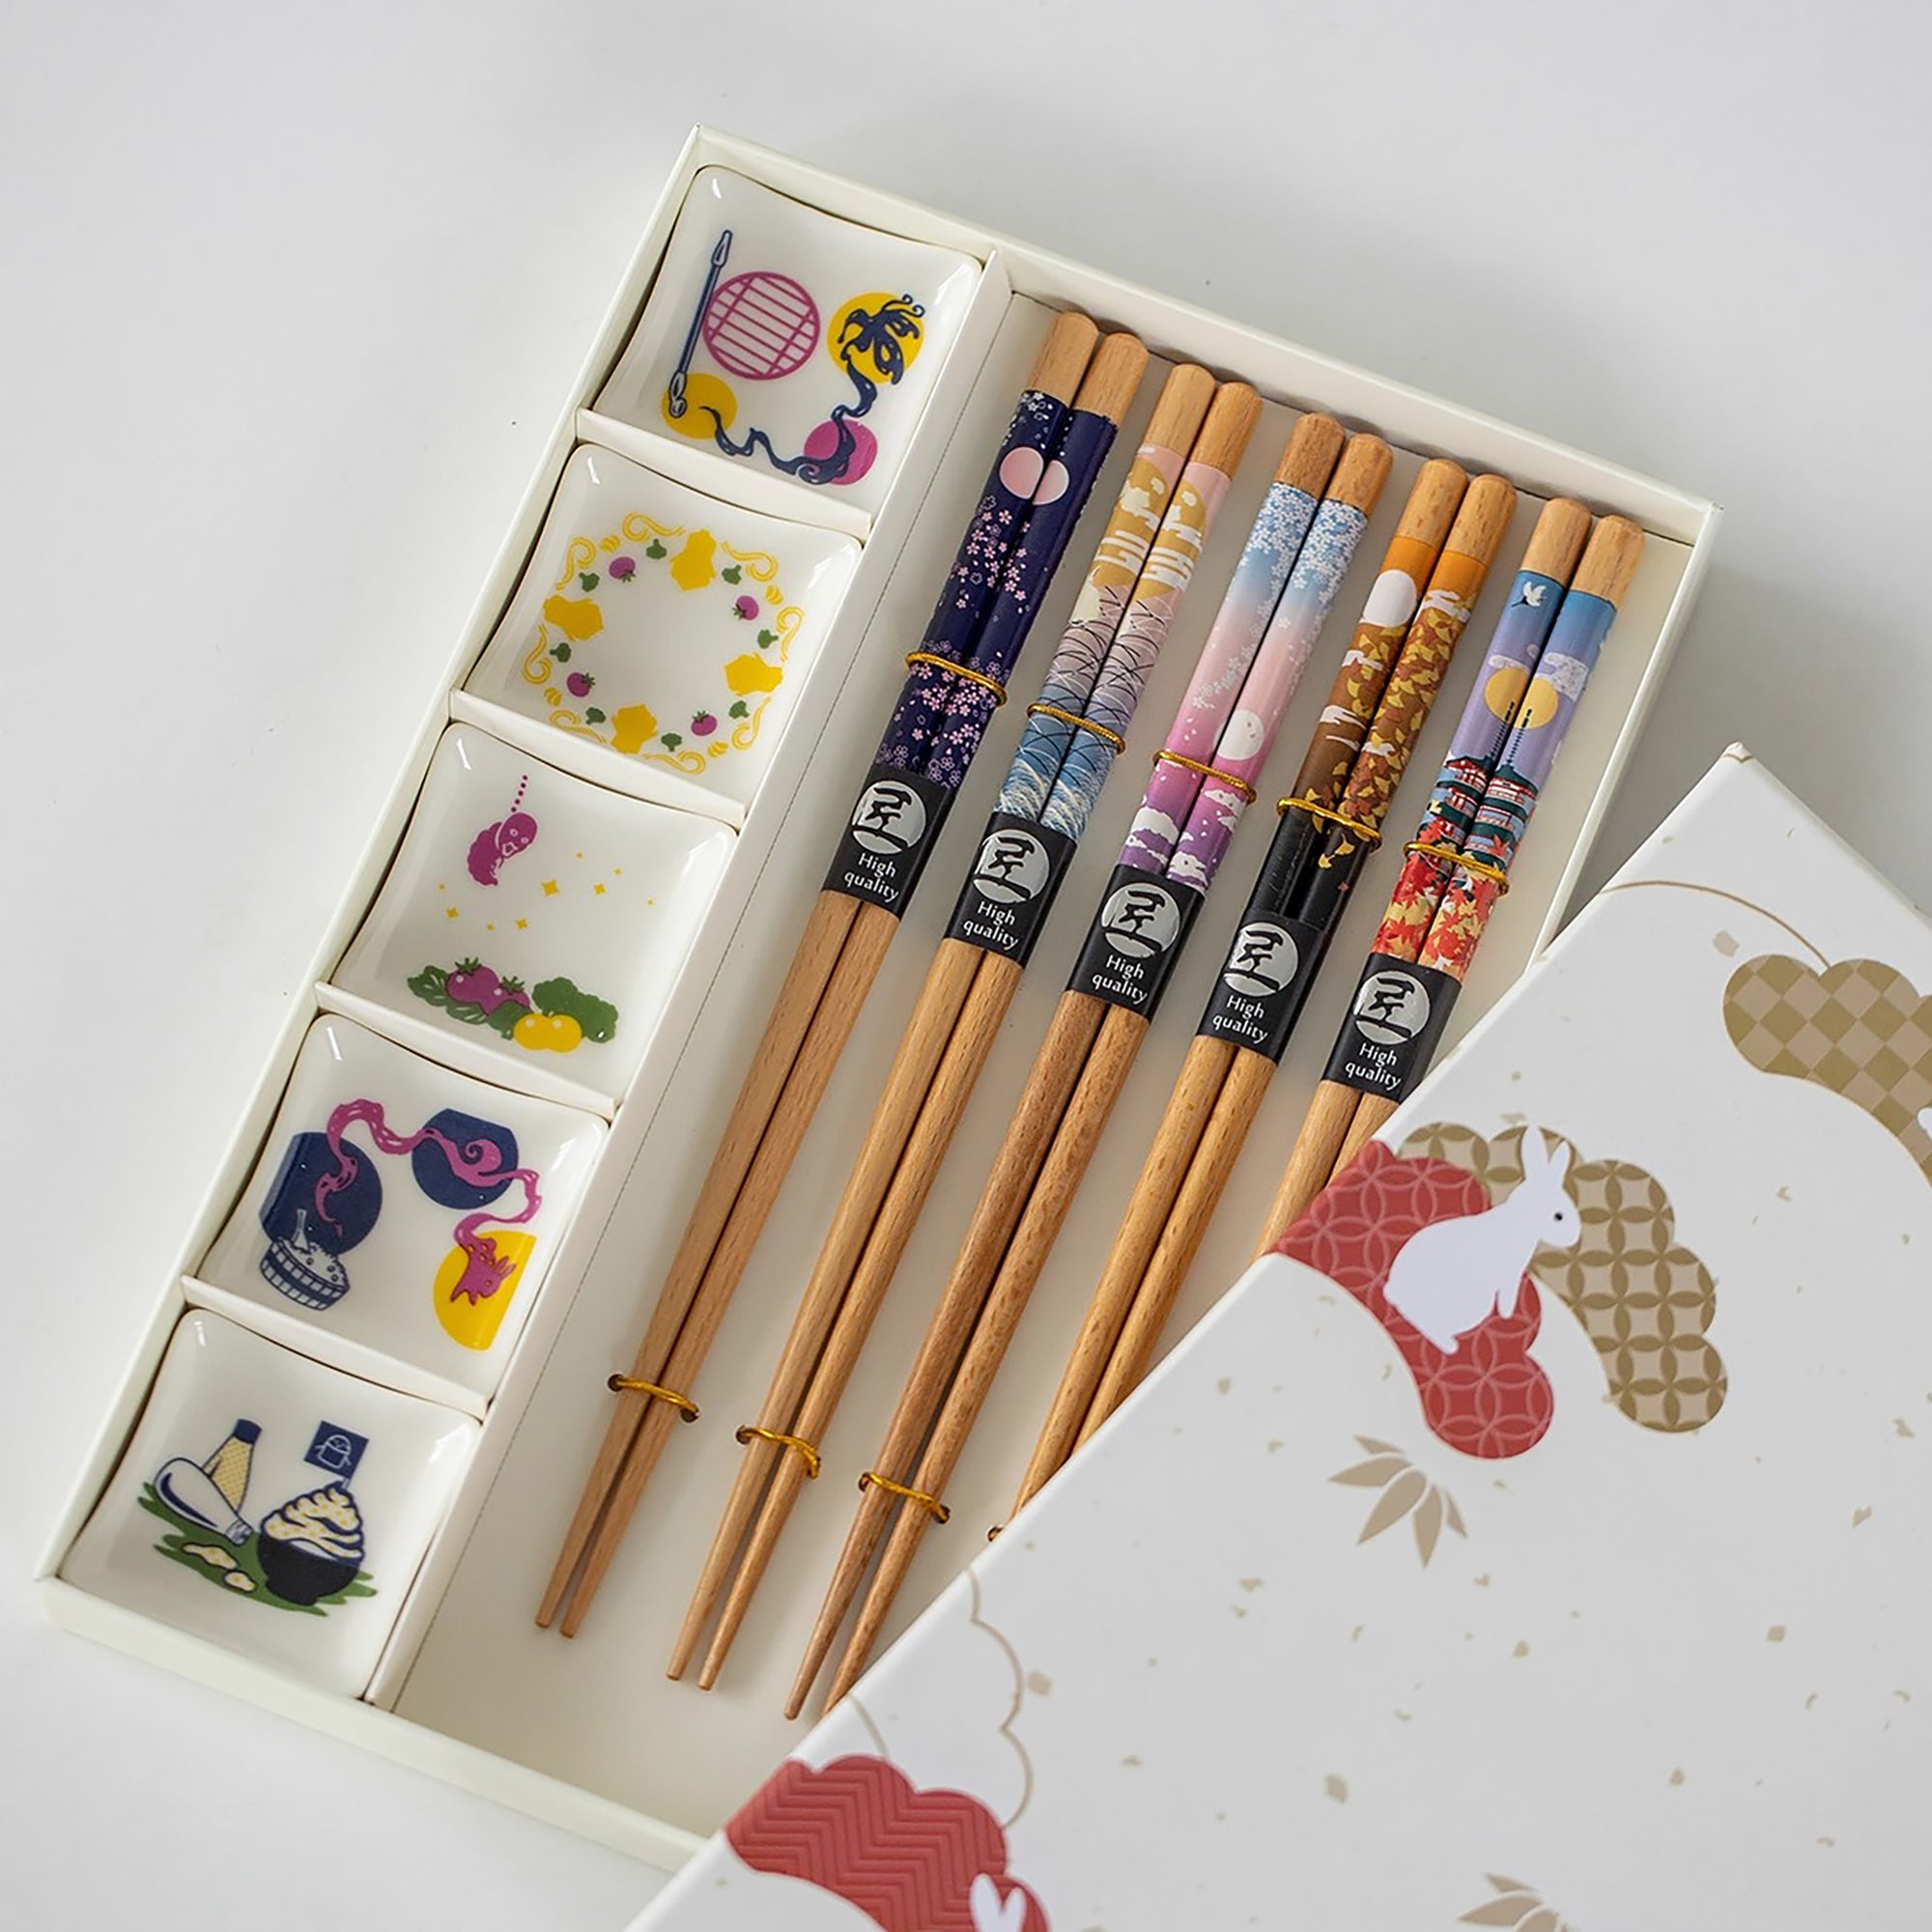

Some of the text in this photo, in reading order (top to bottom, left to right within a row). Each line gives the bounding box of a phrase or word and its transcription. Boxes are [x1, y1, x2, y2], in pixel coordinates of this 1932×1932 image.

[858, 852, 896, 878] High
[843, 871, 899, 903] quality
[977, 900, 1016, 926] High
[963, 920, 1019, 951] quality
[1105, 954, 1145, 980] High
[1092, 974, 1148, 1005] quality
[1226, 995, 1265, 1020] High
[1212, 1013, 1268, 1044] quality
[1358, 1042, 1398, 1067] High
[1345, 1062, 1402, 1091] quality
